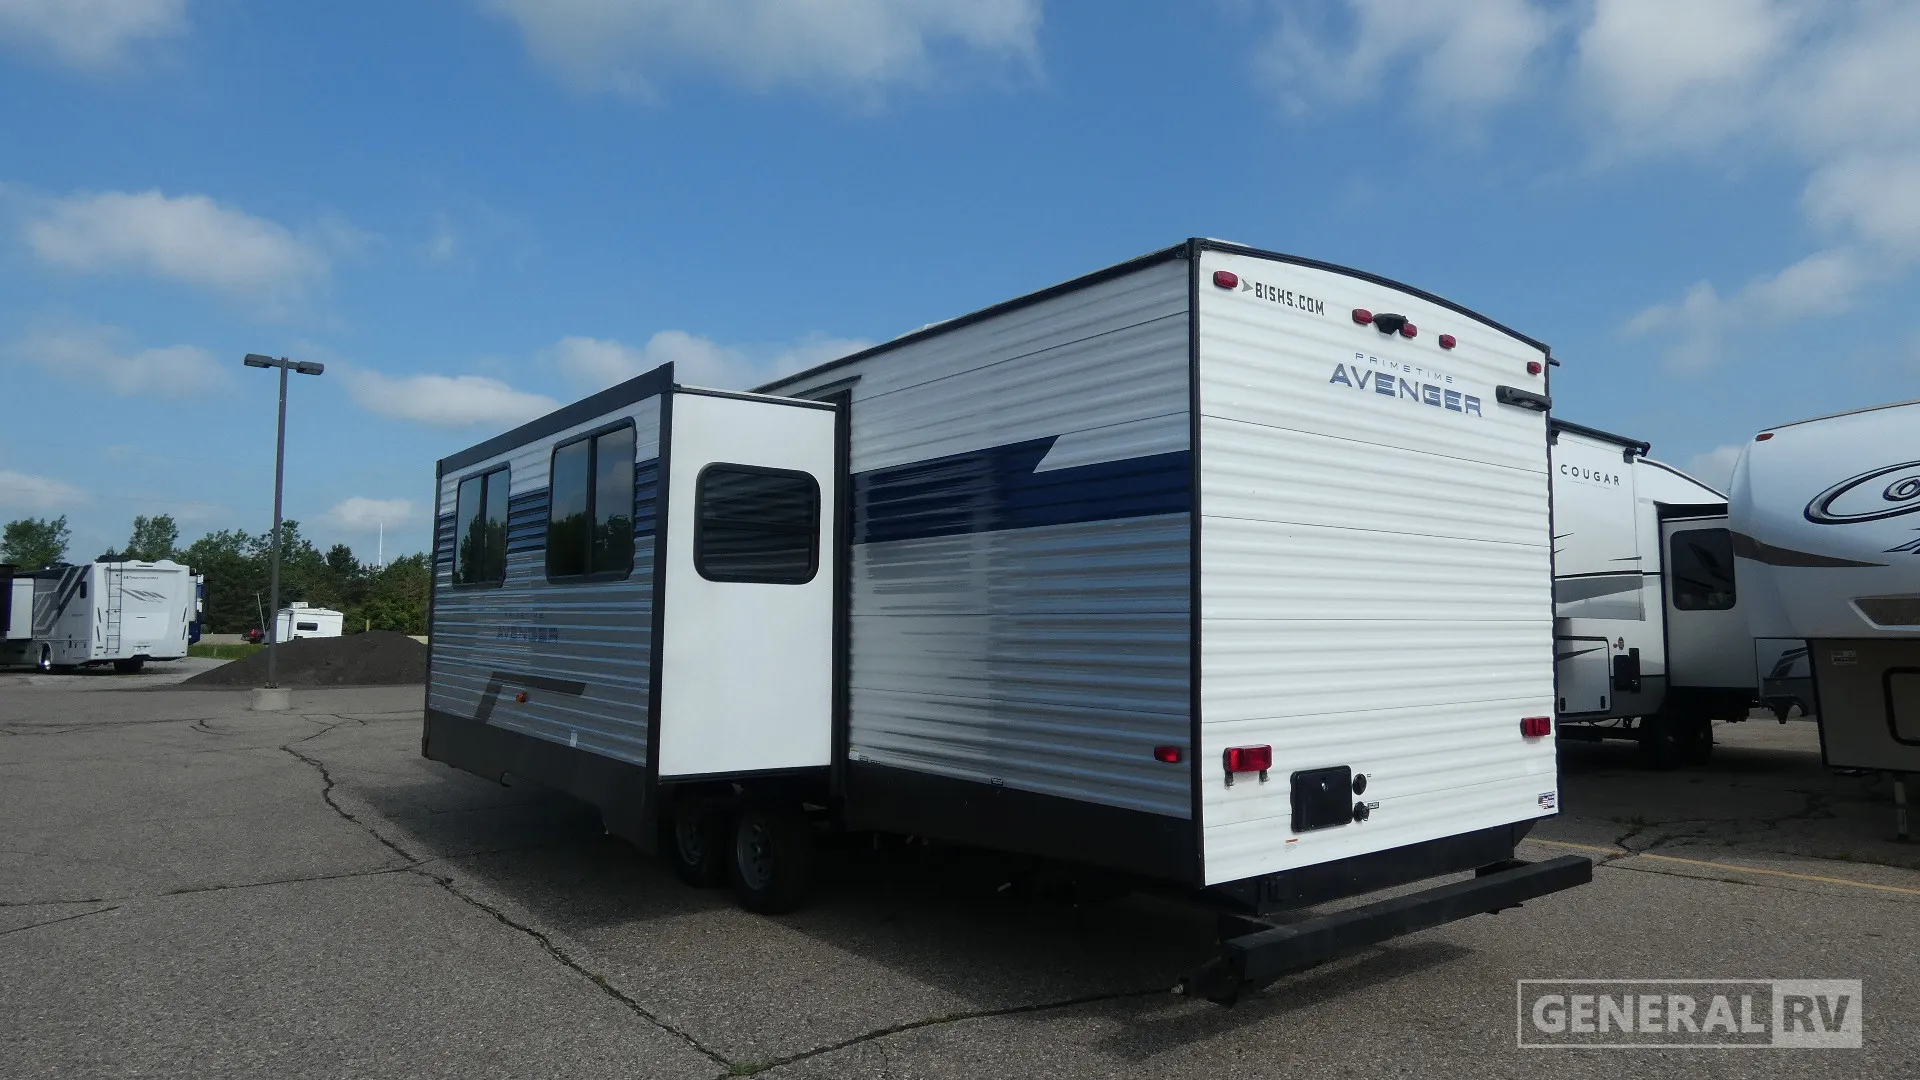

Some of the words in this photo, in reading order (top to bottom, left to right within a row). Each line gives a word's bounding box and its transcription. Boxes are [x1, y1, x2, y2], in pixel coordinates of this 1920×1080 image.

[1255, 281, 1325, 316] BISHS.COM
[1355, 352, 1453, 384] PRIMETIME
[1329, 362, 1483, 418] AVENGER
[1560, 464, 1620, 486] COUGAR
